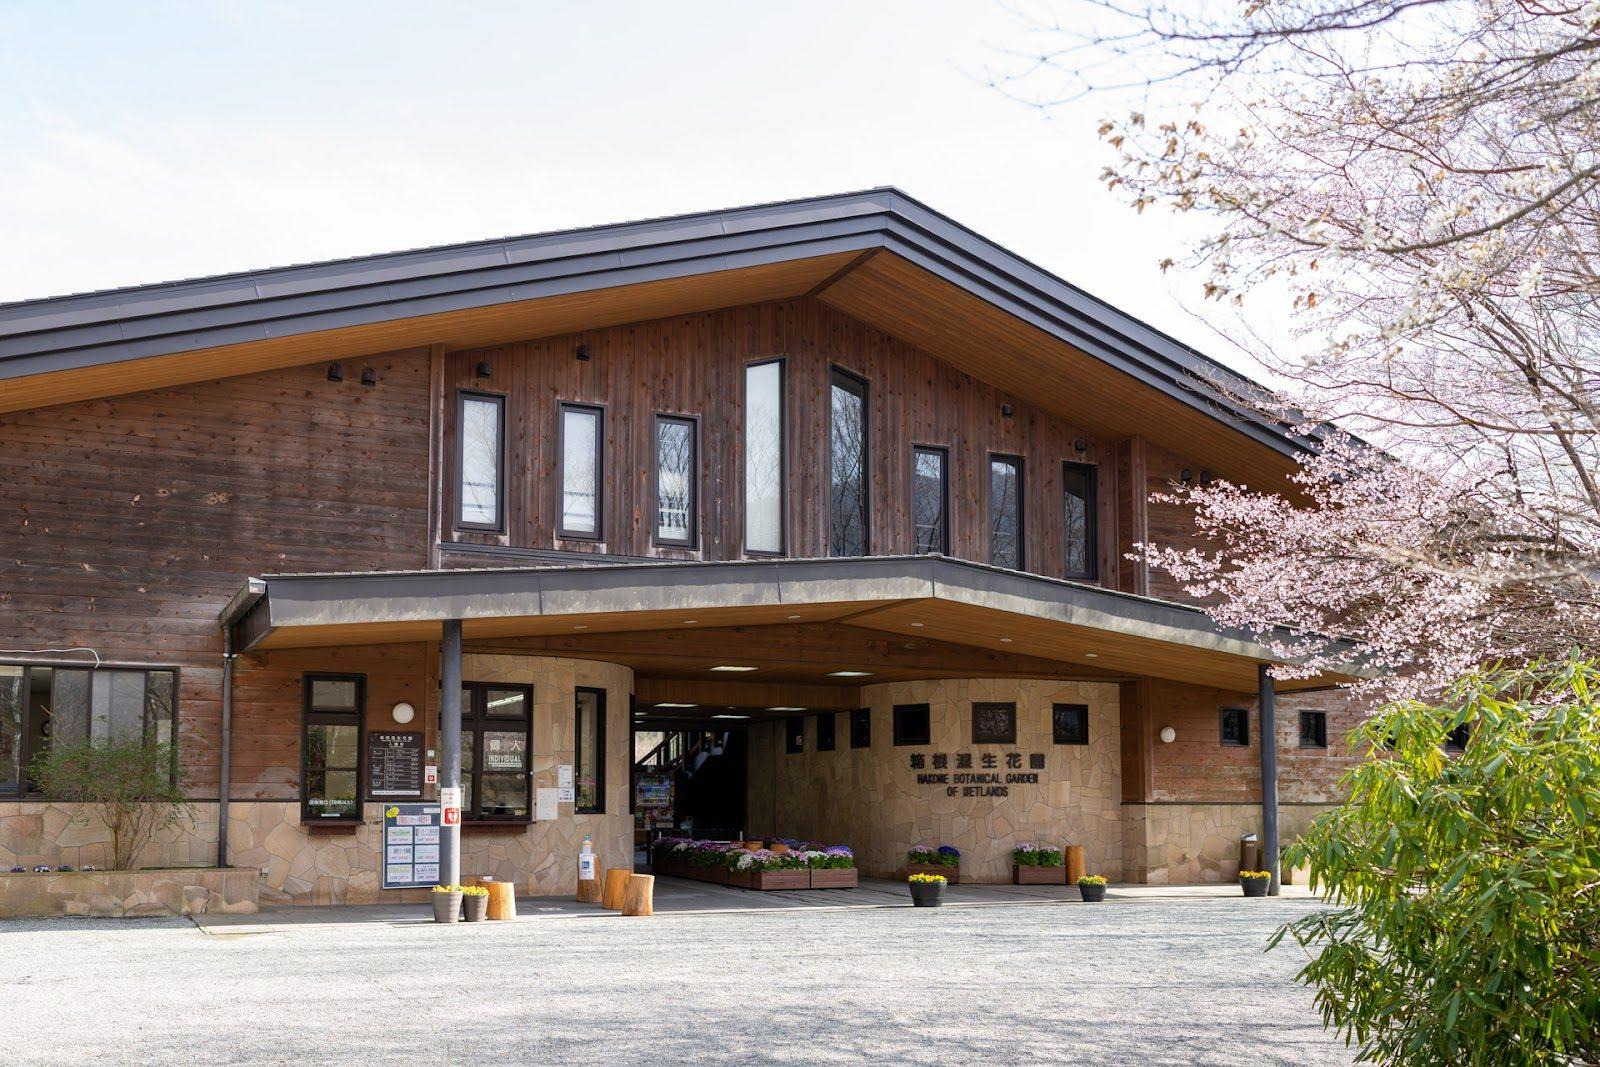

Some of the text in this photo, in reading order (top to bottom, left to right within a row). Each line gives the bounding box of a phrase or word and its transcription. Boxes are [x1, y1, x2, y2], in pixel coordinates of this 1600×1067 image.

[488, 754, 522, 763] INDIVIDUAL
[917, 773, 1038, 784] HAKONE BOTANICAL GARDEN
[946, 786, 1008, 797] OF WETLANDS
